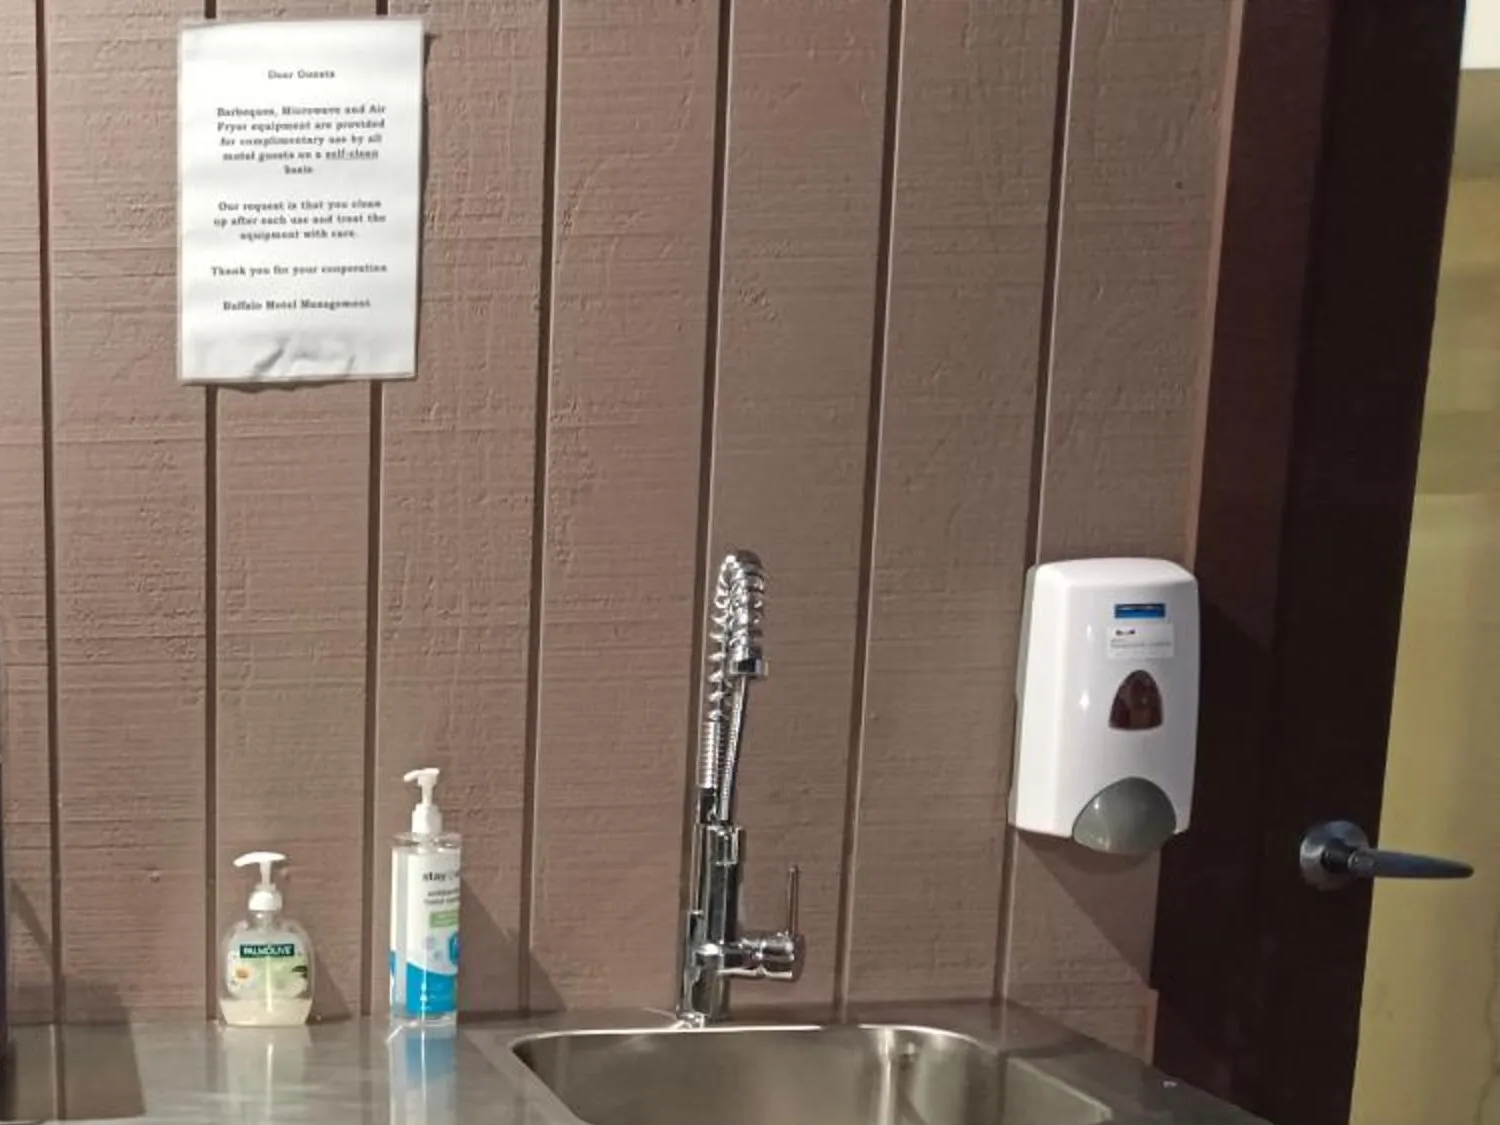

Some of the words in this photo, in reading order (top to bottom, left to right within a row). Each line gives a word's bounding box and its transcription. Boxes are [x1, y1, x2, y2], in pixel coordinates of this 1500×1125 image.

[268, 69, 294, 79] Dear
[297, 69, 336, 79] Guests
[281, 105, 342, 116] Microwave
[344, 104, 367, 115] and
[368, 104, 386, 114] Air
[217, 121, 247, 134] Fryer
[250, 121, 311, 133] equipment
[314, 122, 333, 130] are
[335, 118, 385, 131] provided
[220, 137, 236, 146] for
[239, 136, 325, 147] complimentary
[328, 136, 348, 144] use
[349, 134, 365, 145] by
[367, 133, 383, 144] all
[222, 151, 256, 161] motel
[258, 151, 295, 163] guests
[297, 151, 312, 159] on
[315, 151, 322, 159] a
[218, 201, 240, 211] Our
[242, 202, 285, 213] request
[287, 202, 298, 210] is
[300, 200, 325, 210] that
[326, 201, 349, 211] you
[351, 199, 382, 209] clean
[213, 218, 228, 228] up
[230, 215, 258, 225] after
[260, 214, 287, 225] each
[290, 216, 310, 225] use
[311, 215, 333, 224] and
[336, 214, 364, 224] treat
[367, 212, 387, 223] the
[239, 230, 300, 243] equipment
[303, 229, 328, 239] with
[211, 266, 246, 276] Thank
[249, 267, 271, 277] you
[273, 265, 289, 275] for
[292, 266, 318, 276] your
[321, 264, 388, 275] cooperation
[223, 300, 263, 311] Buffalo
[265, 300, 297, 310] Motel
[300, 298, 371, 311] Management
